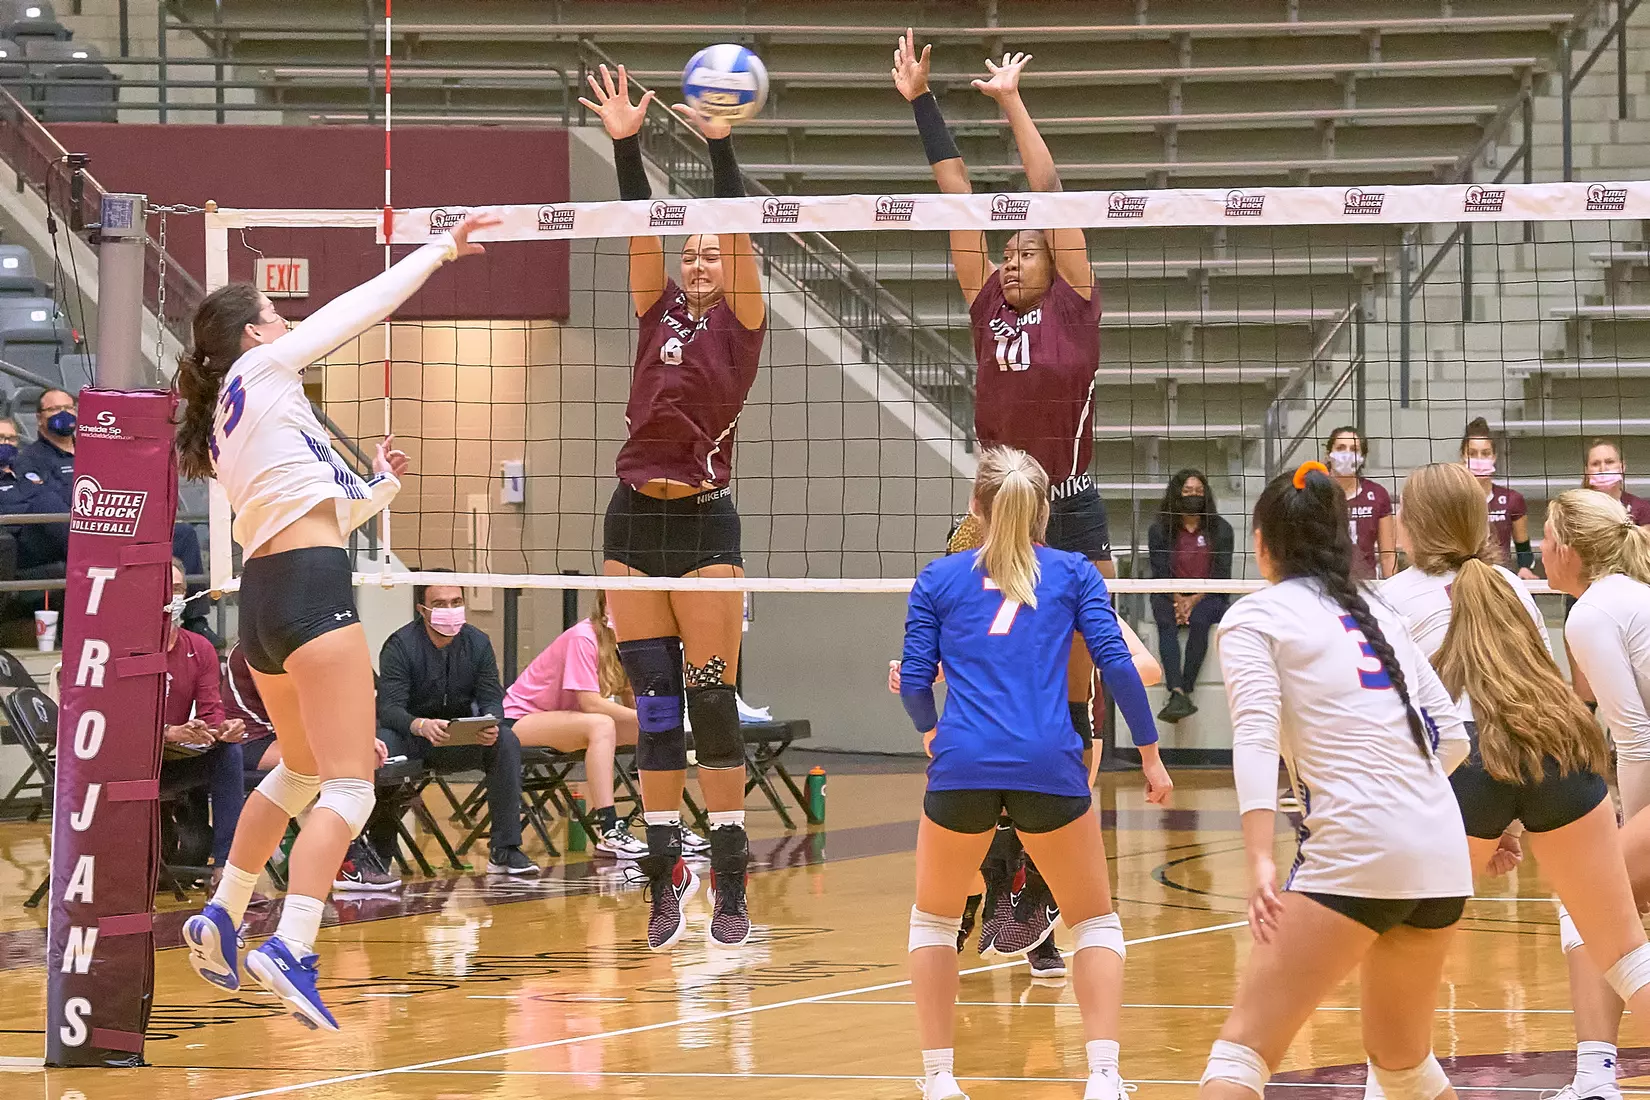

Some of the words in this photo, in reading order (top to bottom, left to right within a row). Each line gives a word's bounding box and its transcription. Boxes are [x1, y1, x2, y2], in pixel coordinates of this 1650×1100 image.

[266, 264, 300, 291] EXIT
[660, 337, 684, 366] 6
[994, 331, 1030, 371] 10
[79, 425, 108, 434] Schelde
[97, 493, 142, 507] LITTLE
[697, 490, 720, 505] NIKE
[1051, 473, 1090, 501] NIKE
[93, 506, 139, 519] ROCK
[982, 576, 1022, 636] 7
[1338, 614, 1394, 690] 3
[60, 567, 117, 1048] TROJANS
